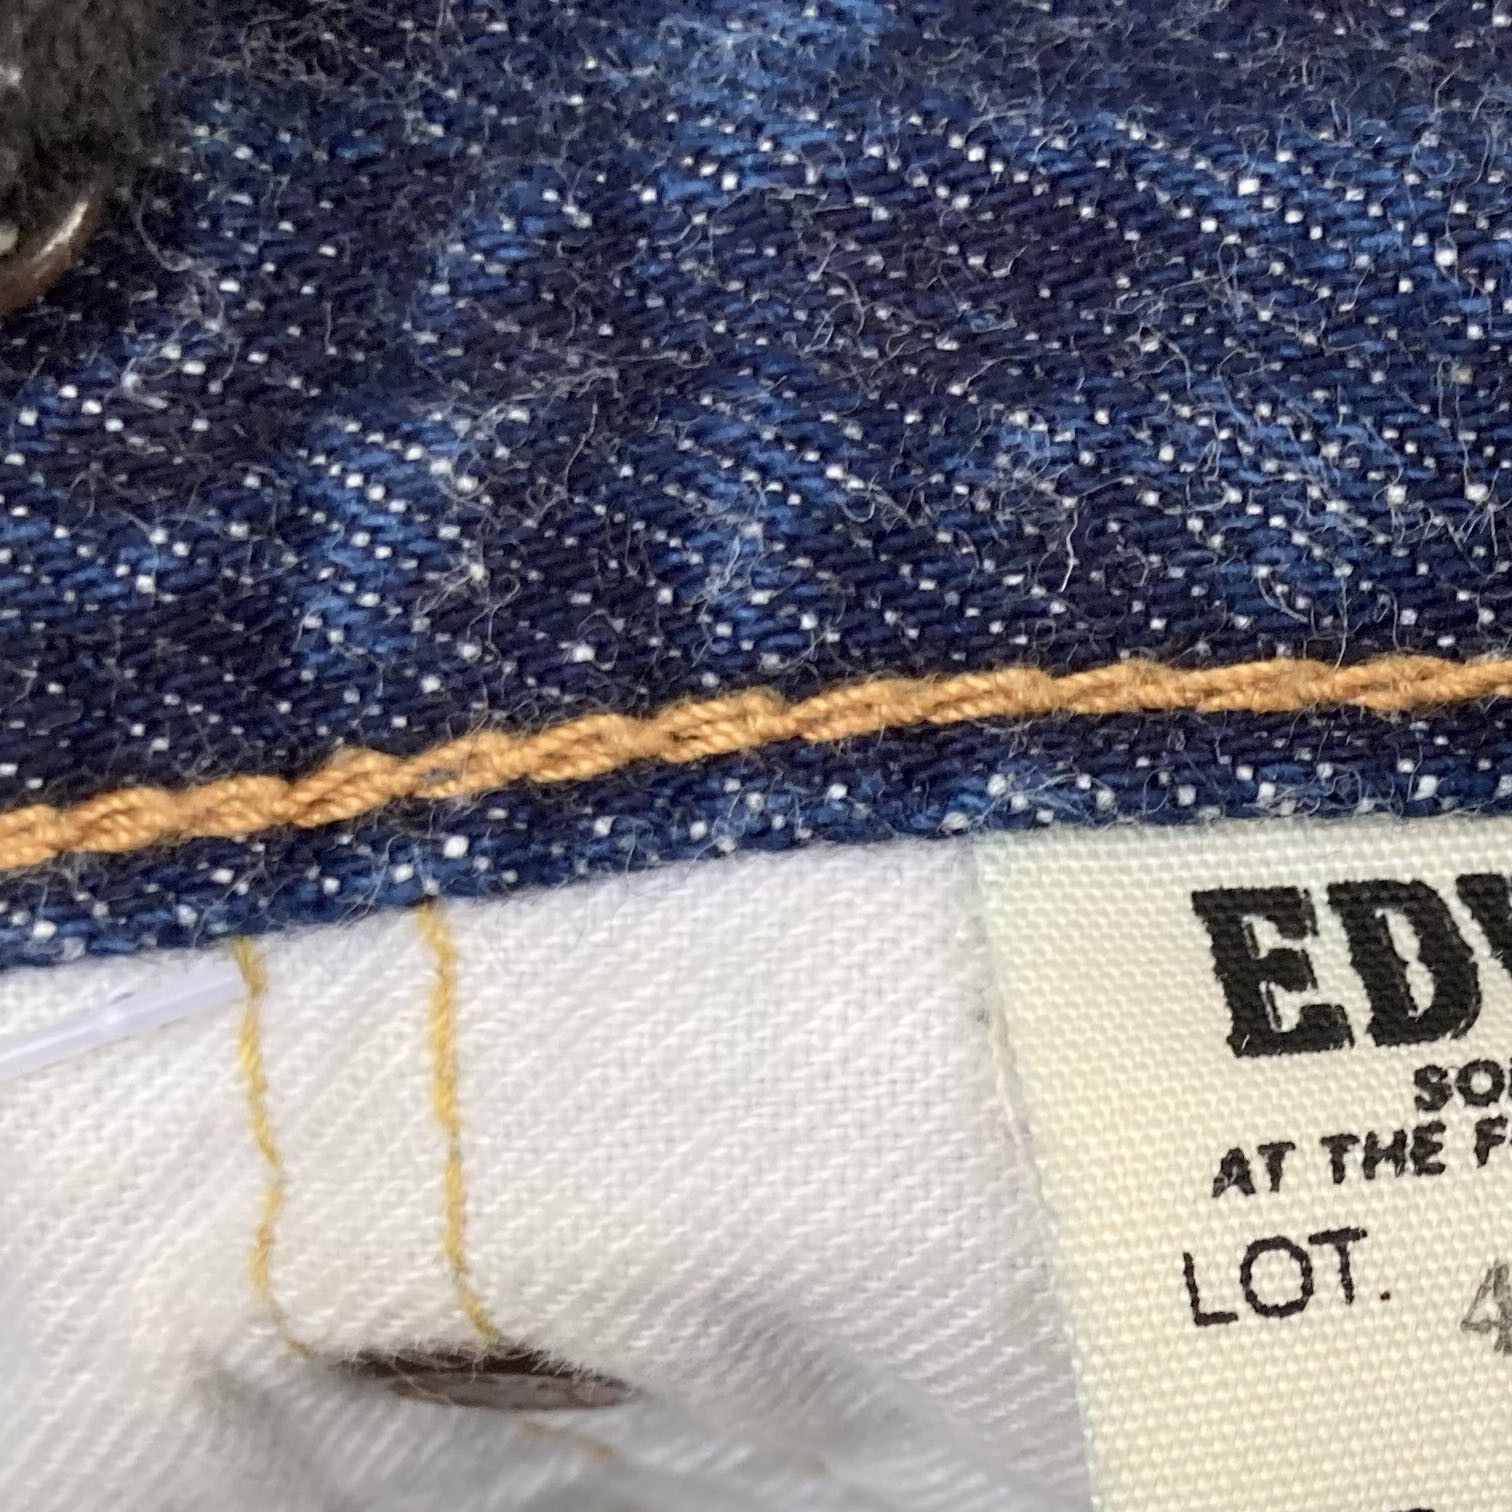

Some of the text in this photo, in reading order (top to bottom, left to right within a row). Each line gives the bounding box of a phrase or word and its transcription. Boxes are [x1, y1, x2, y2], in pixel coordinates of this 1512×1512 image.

[1210, 1139, 1298, 1200] AT
[1318, 1118, 1448, 1187] THE
[1181, 1225, 1393, 1329] LOT.
